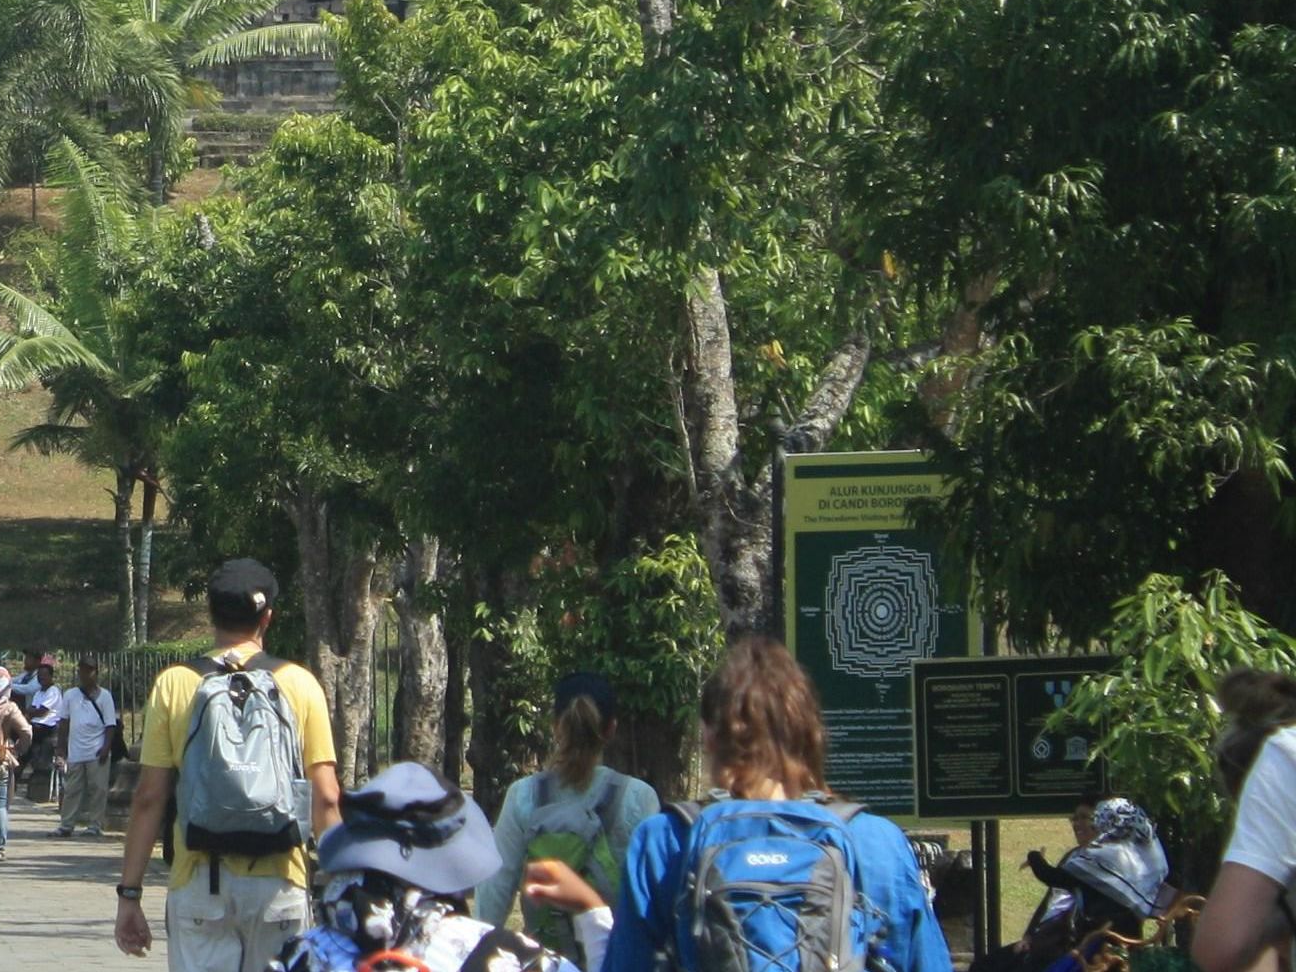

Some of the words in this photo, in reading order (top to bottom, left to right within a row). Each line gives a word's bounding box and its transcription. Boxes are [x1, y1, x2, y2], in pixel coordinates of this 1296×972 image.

[830, 486, 858, 497] ALUR
[861, 484, 932, 496] KUNJUNGAN
[818, 500, 830, 510] DI
[833, 498, 869, 510] CANDI
